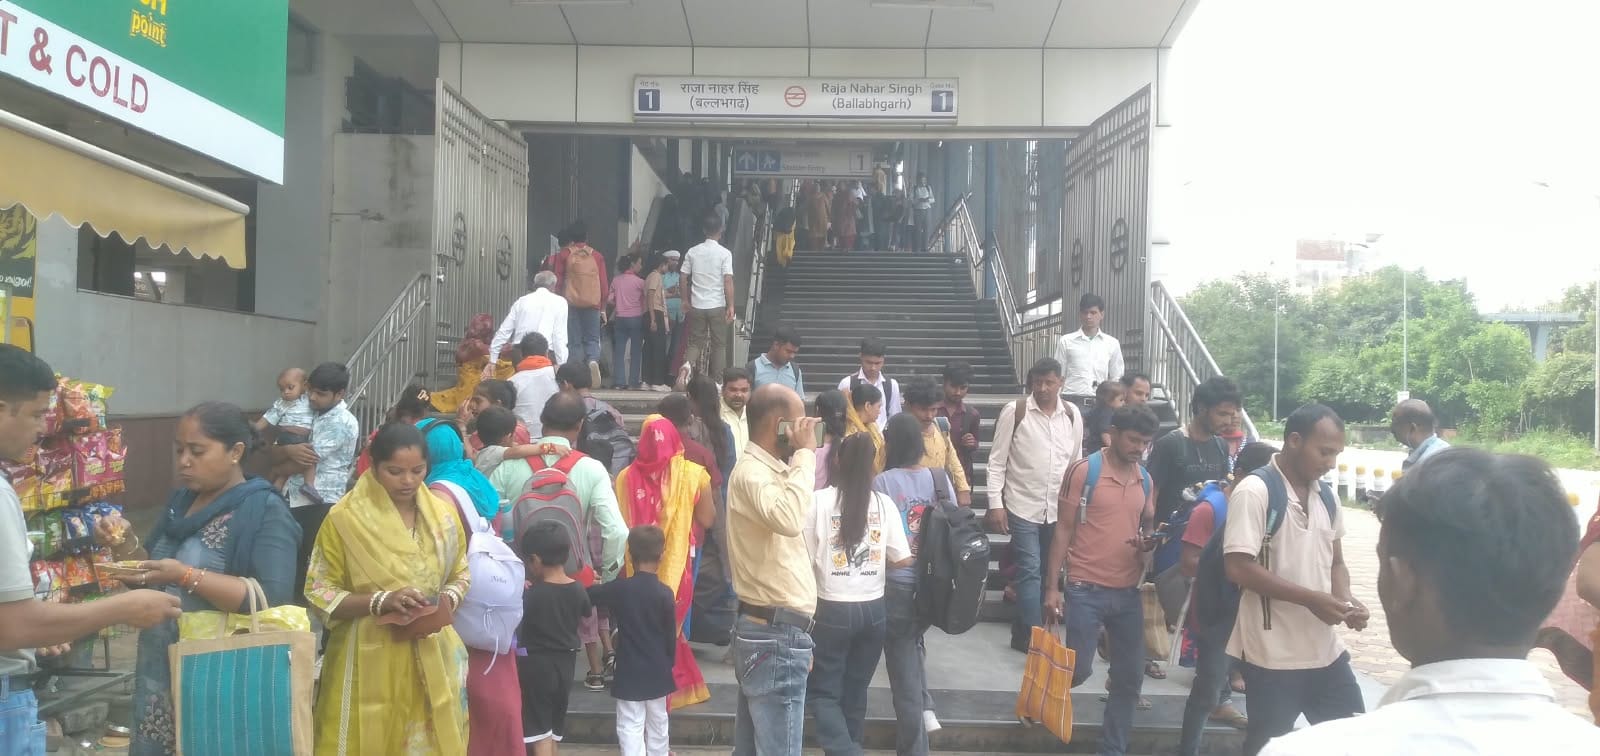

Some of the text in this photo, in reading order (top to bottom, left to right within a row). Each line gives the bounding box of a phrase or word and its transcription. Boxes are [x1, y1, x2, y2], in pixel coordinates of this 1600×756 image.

[130, 10, 167, 46] point
[29, 27, 53, 75] &
[65, 45, 149, 113] COLD
[680, 79, 760, 95] राजा नाहर सिंह
[821, 82, 922, 96] Raja Nahar Singh
[645, 91, 653, 109] 1
[832, 97, 912, 112] (Ballabhgarh)
[938, 92, 947, 110] 1
[857, 154, 864, 170] 1
